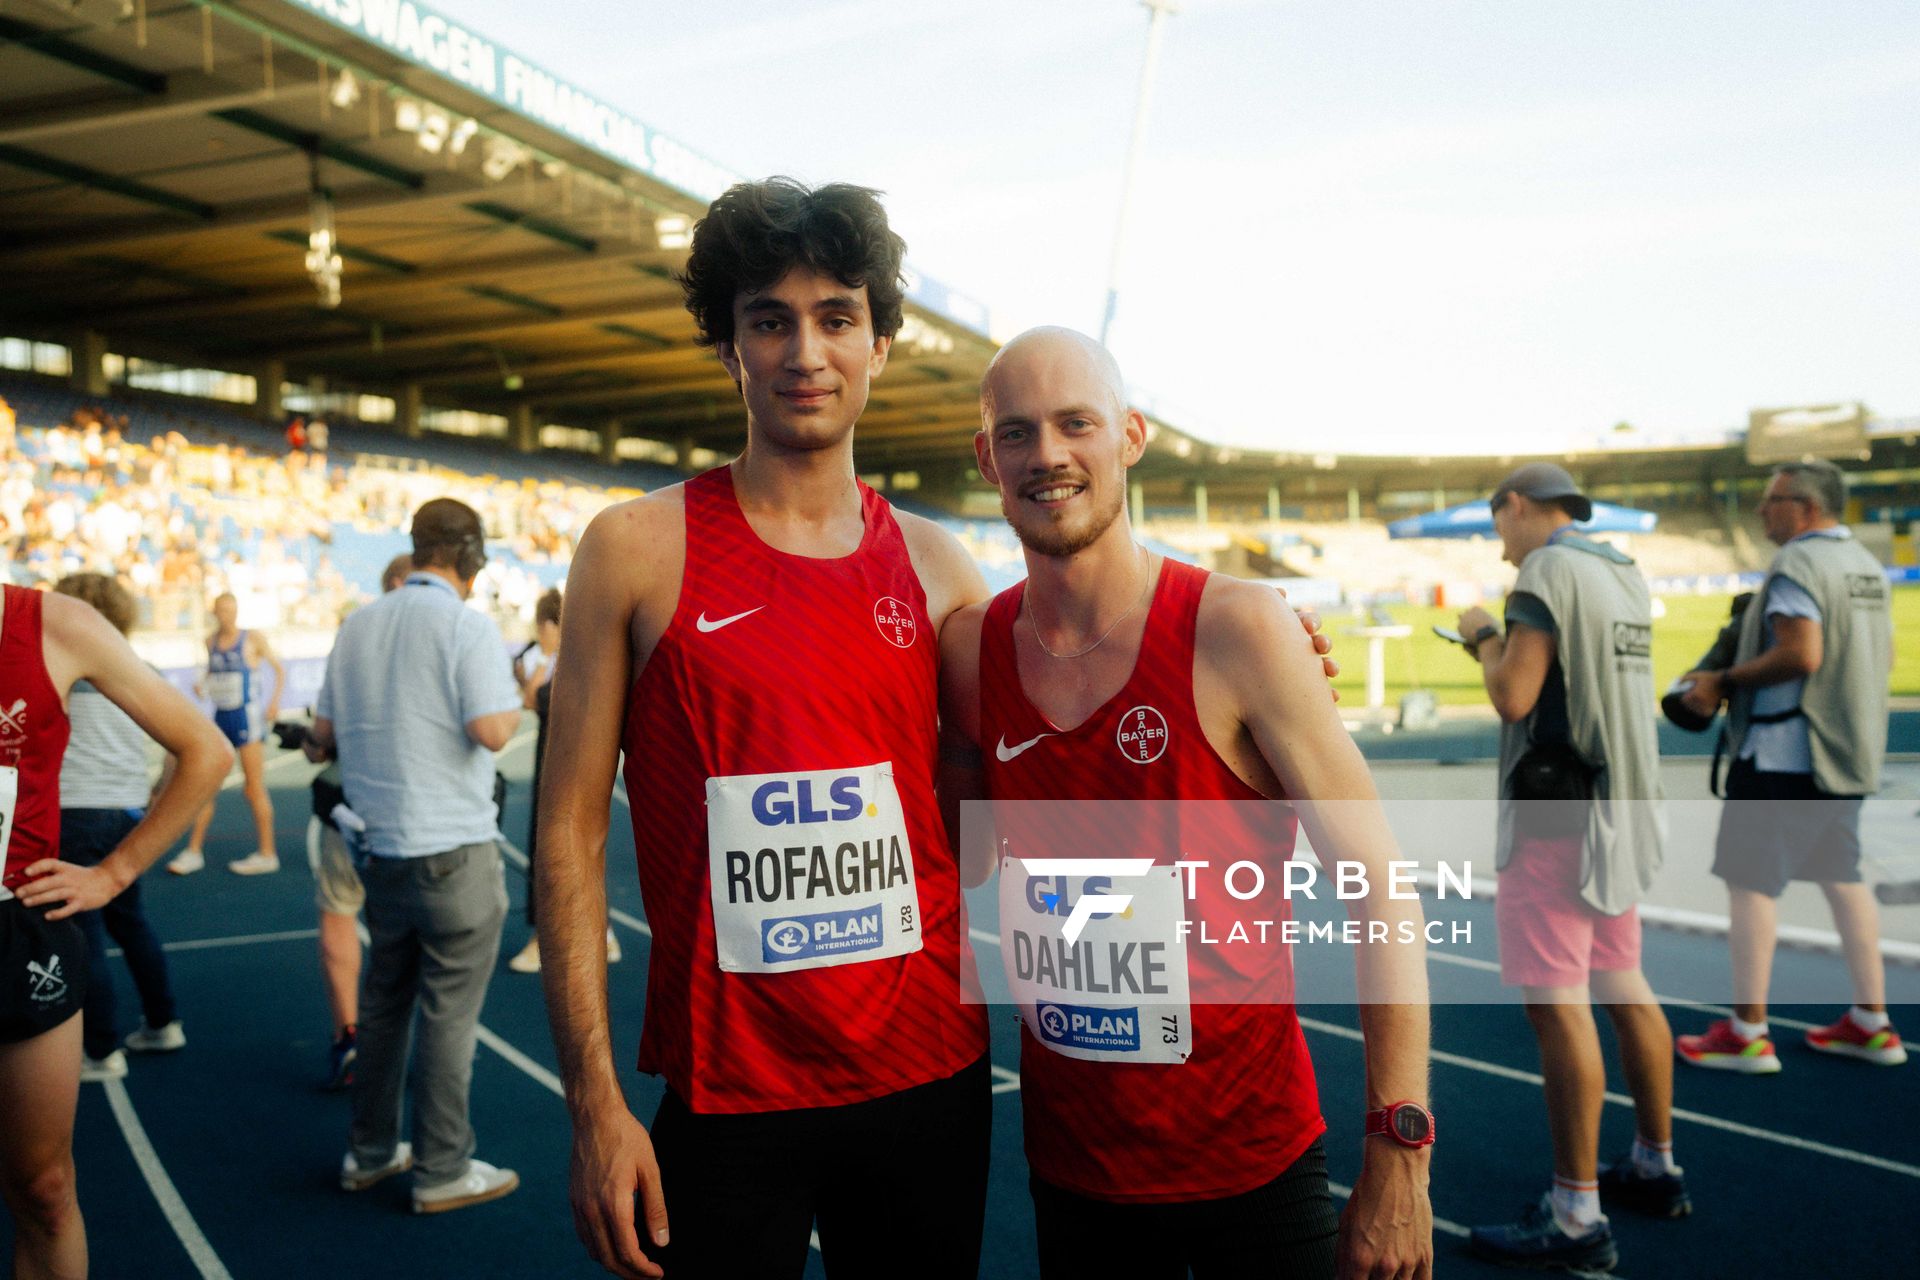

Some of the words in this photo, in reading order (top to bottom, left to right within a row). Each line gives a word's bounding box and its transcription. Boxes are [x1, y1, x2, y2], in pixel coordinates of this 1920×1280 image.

[878, 614, 914, 629] BAYER
[889, 600, 904, 645] BAYER
[1121, 728, 1165, 743] BAYER
[1137, 711, 1149, 760] BAYER
[726, 835, 909, 904] ROFAGHA
[813, 914, 878, 941] PLAN
[900, 904, 914, 934] 821
[815, 936, 879, 951] INTERNATIONAL
[1013, 929, 1169, 995] DAHLKE
[1071, 1013, 1135, 1036] PLAN
[1161, 1014, 1179, 1045] 773
[1073, 1035, 1135, 1047] INTERNATIONAL
